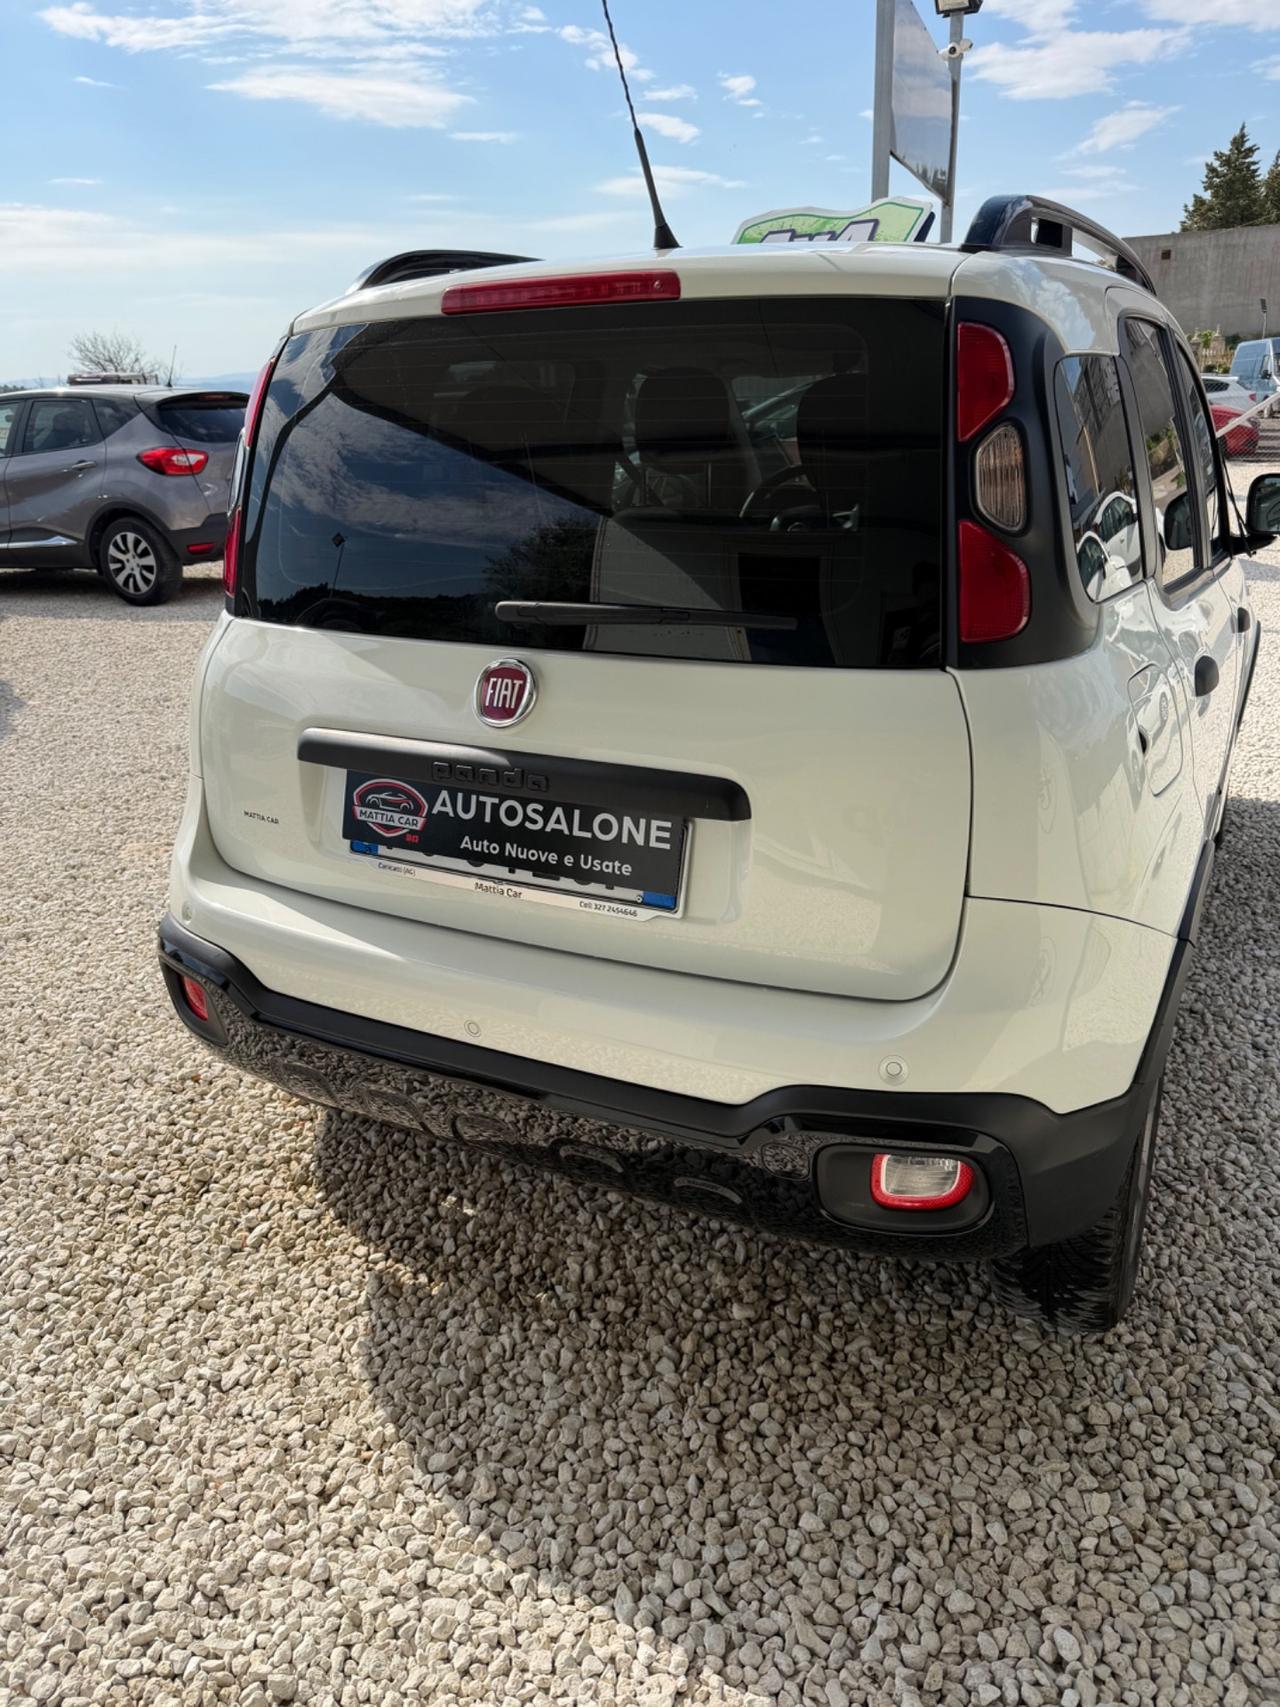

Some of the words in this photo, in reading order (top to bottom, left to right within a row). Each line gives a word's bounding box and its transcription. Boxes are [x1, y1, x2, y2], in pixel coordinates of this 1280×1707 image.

[485, 678, 524, 709] FIAT
[432, 761, 549, 792] panda
[360, 809, 395, 823] MATTIA
[398, 816, 419, 828] CAR
[431, 790, 673, 850] AUTOSALONE
[460, 835, 500, 854] Auto
[504, 843, 559, 865] Nuove
[563, 854, 575, 867] e
[580, 854, 633, 876] Usate
[474, 882, 505, 896] Mattia
[506, 888, 522, 898] Car
